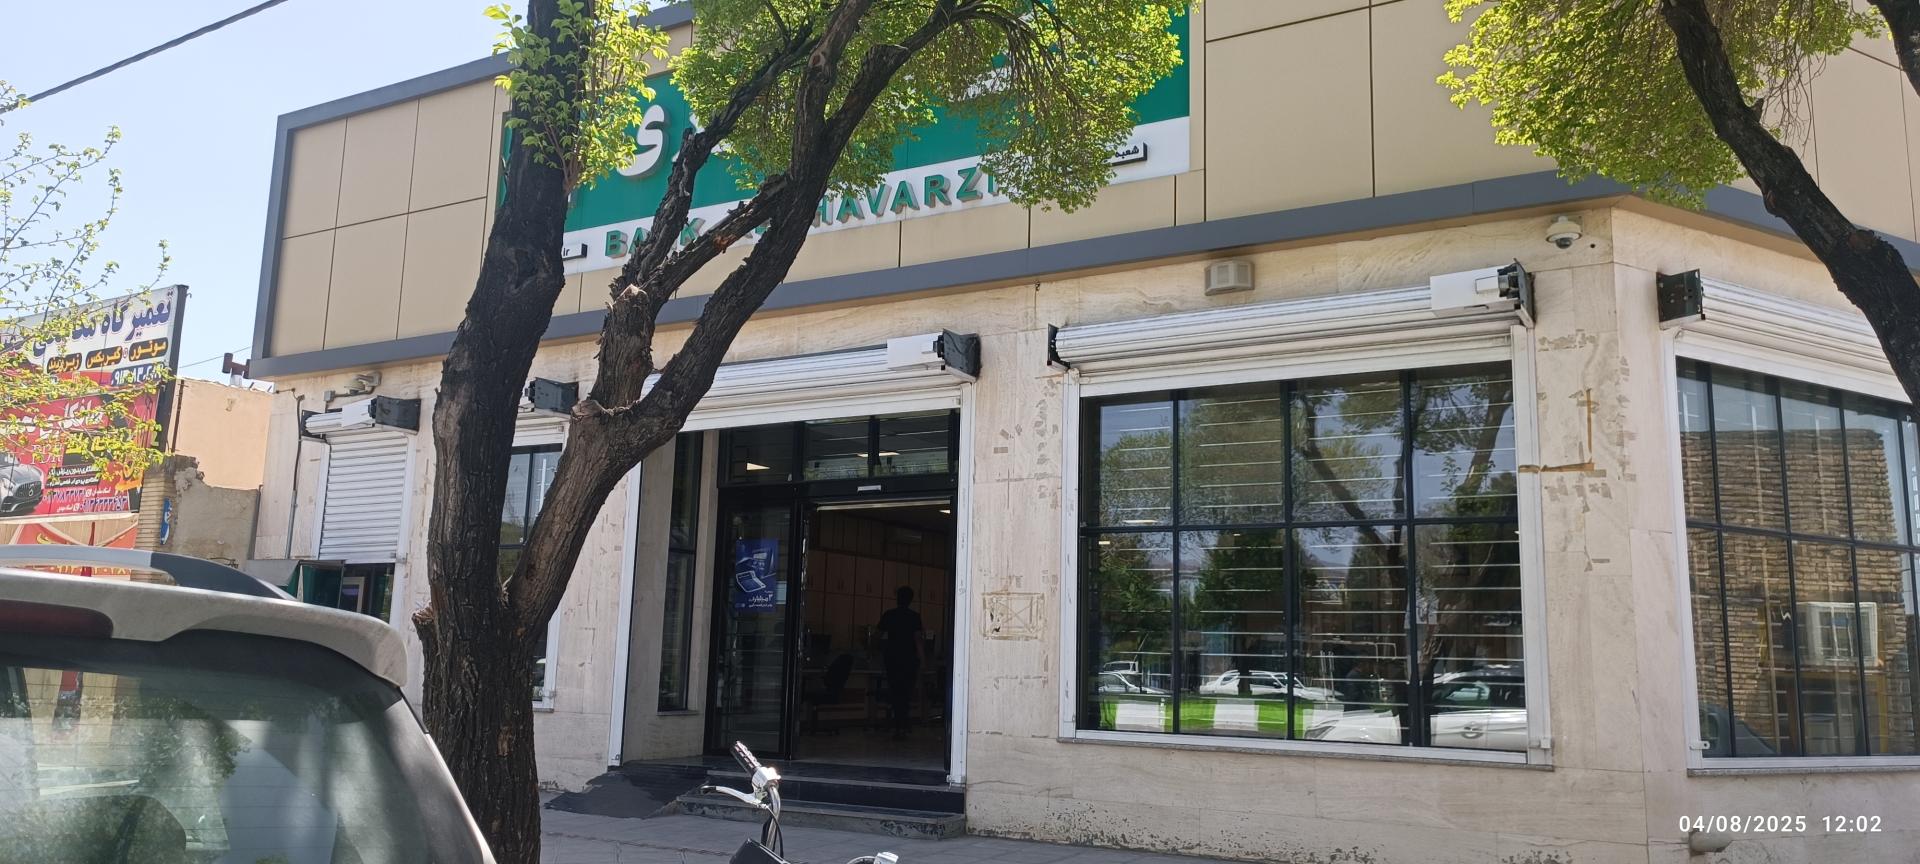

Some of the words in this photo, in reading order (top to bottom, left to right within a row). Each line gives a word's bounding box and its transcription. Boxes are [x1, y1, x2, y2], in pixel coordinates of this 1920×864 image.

[1115, 145, 1139, 159] شعبه
[605, 218, 706, 257] BAK
[130, 340, 166, 361] موتور
